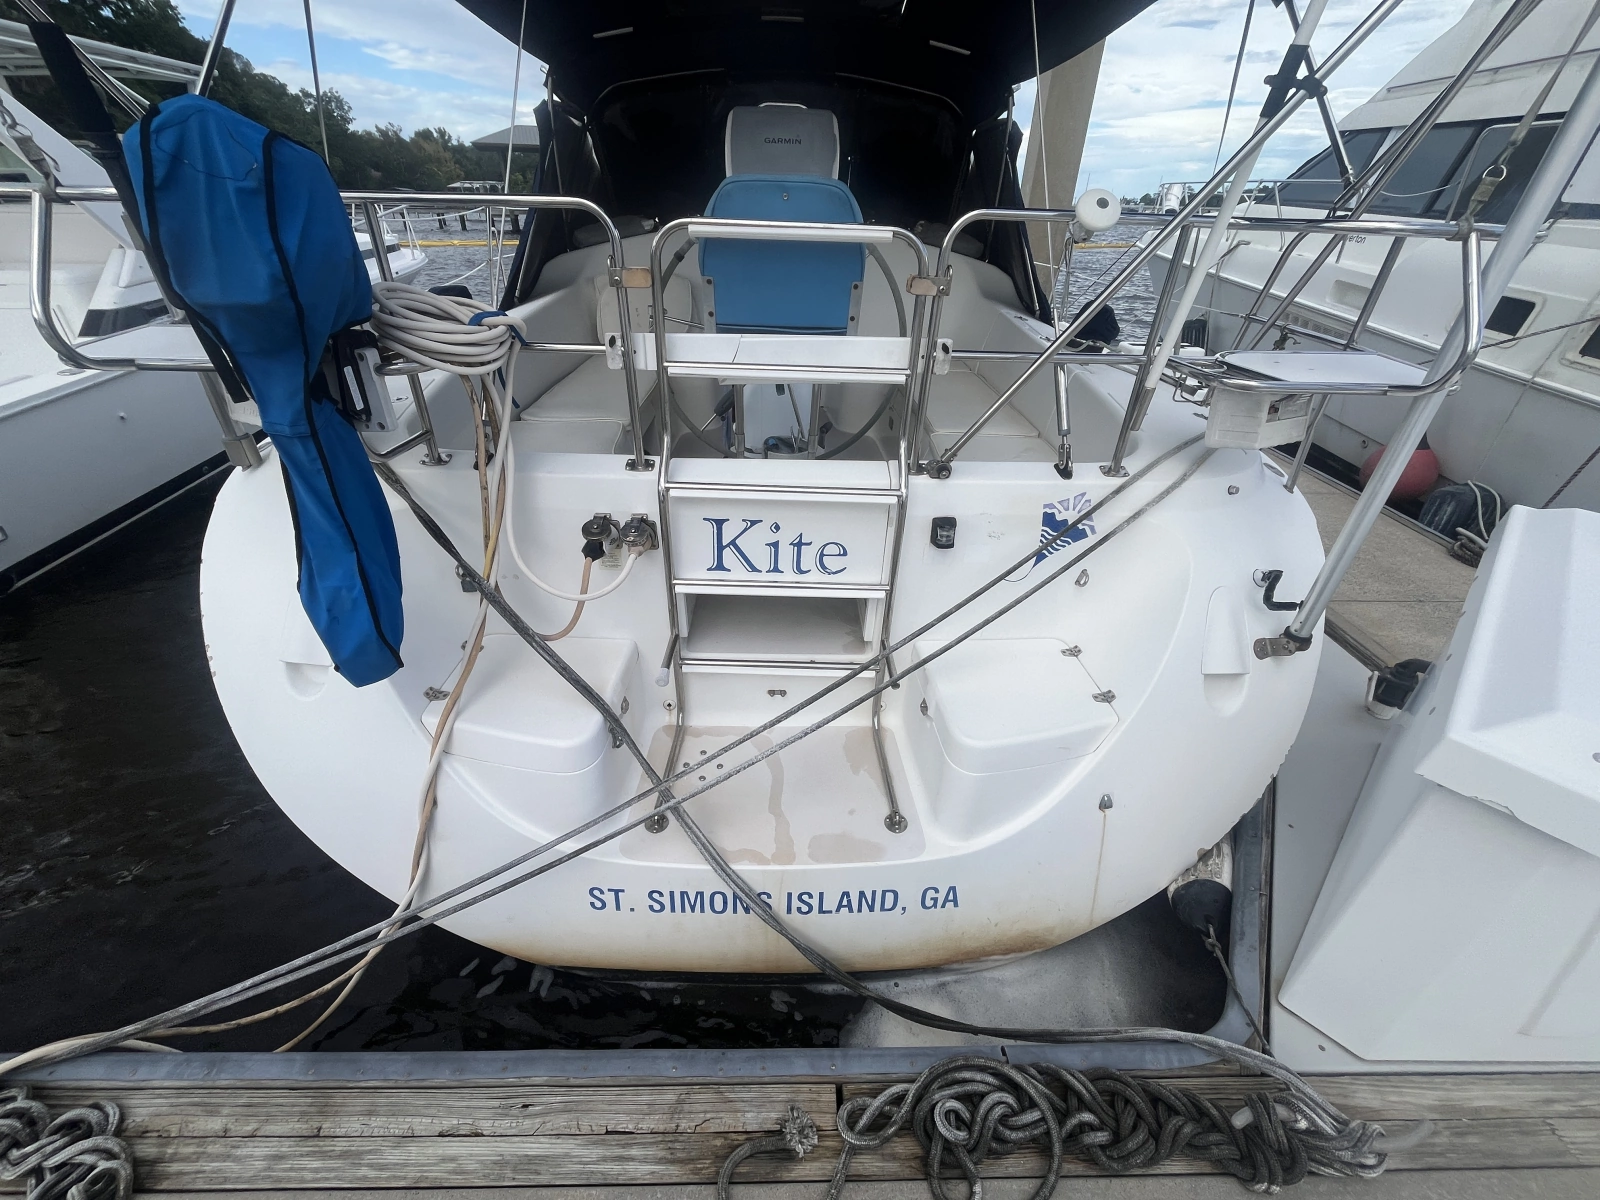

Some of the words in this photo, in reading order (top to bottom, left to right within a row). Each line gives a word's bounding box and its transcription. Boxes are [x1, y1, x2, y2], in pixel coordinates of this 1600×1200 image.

[764, 137, 802, 145] GARMIN
[1348, 234, 1367, 244] erton
[702, 517, 848, 575] Kite
[588, 886, 635, 912] ST.
[786, 889, 907, 916] ISLAND,
[920, 885, 960, 910] GA
